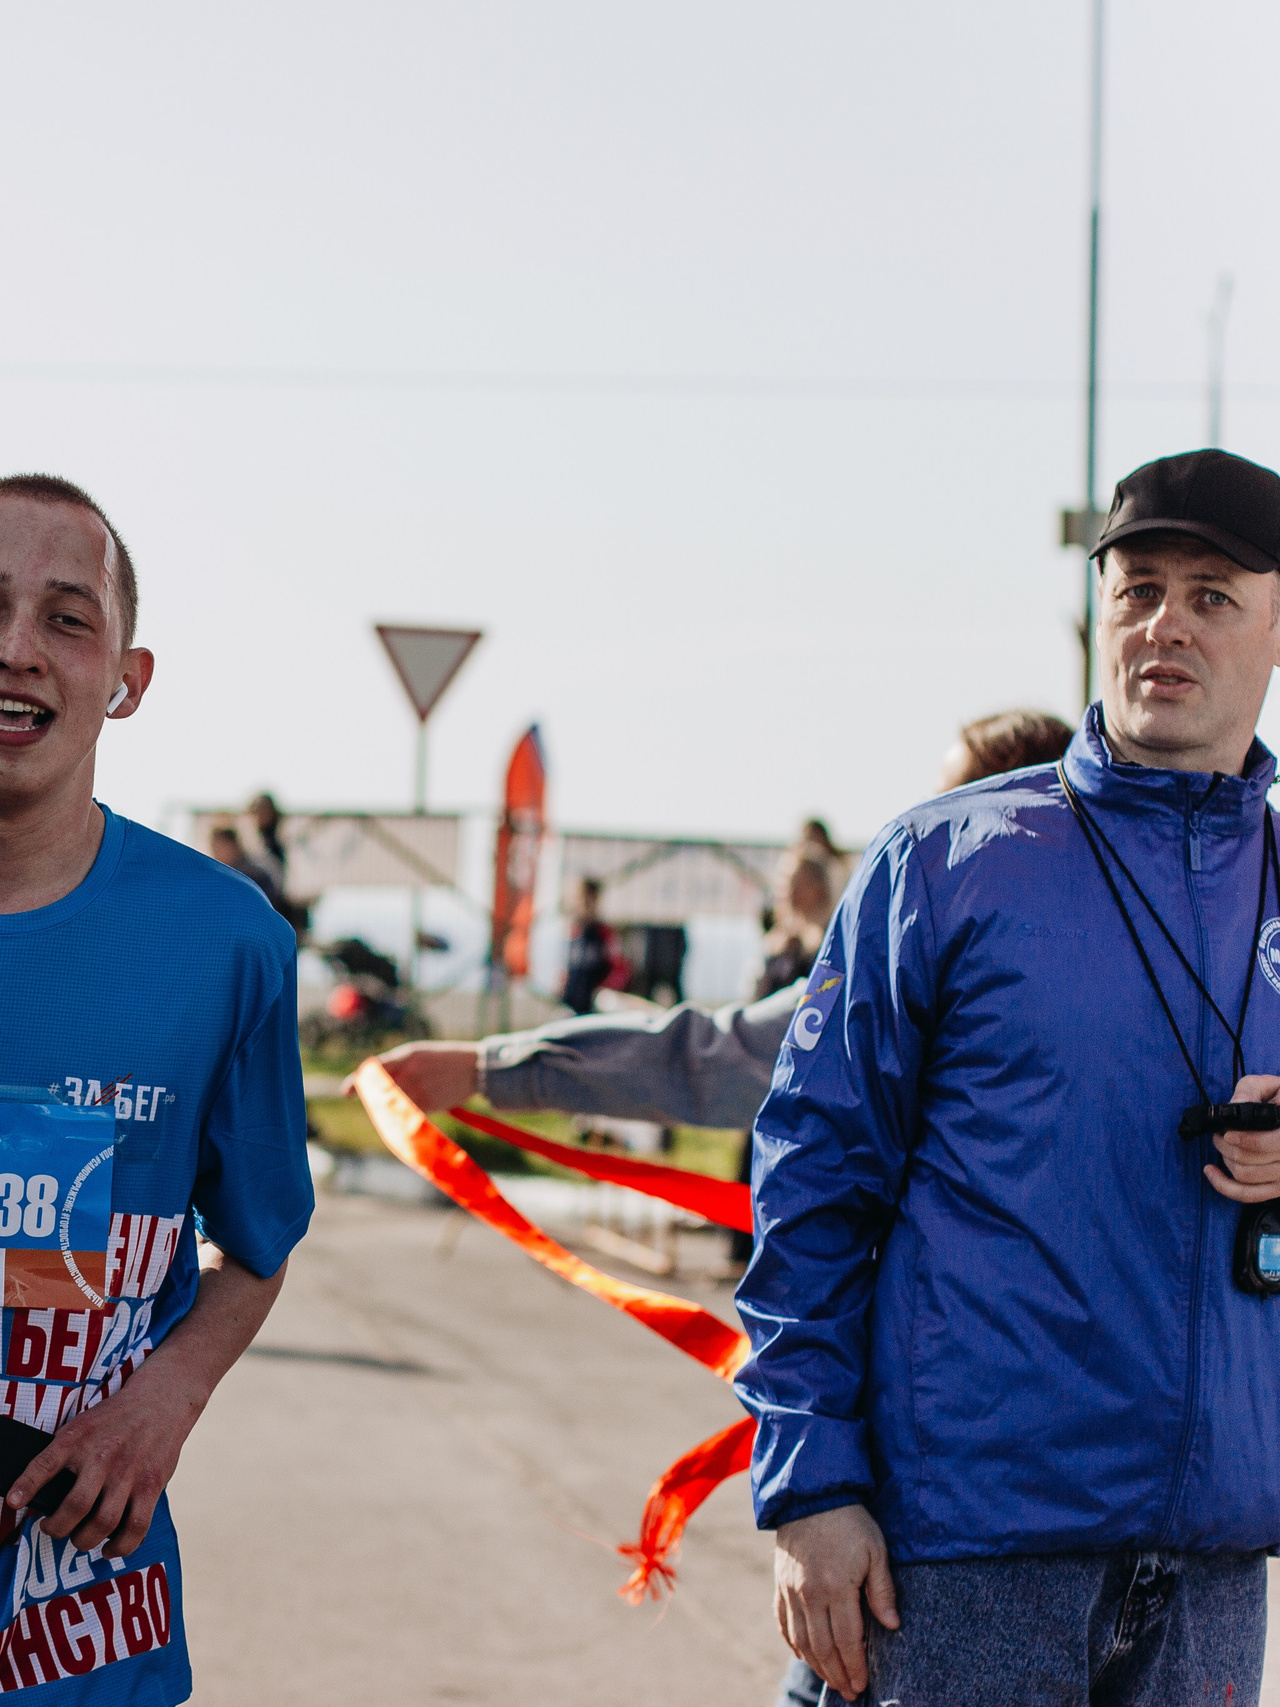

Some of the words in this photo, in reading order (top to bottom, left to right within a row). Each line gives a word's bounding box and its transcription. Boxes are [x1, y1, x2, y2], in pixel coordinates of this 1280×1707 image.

[62, 1155, 101, 1213] #САМОВЫРАЖЕНИЕ
[59, 1212, 70, 1251] #ГОРДОСТЬ
[62, 1250, 87, 1288] #ЕДИНСТВО
[81, 1284, 104, 1308] #МЕЧТА
